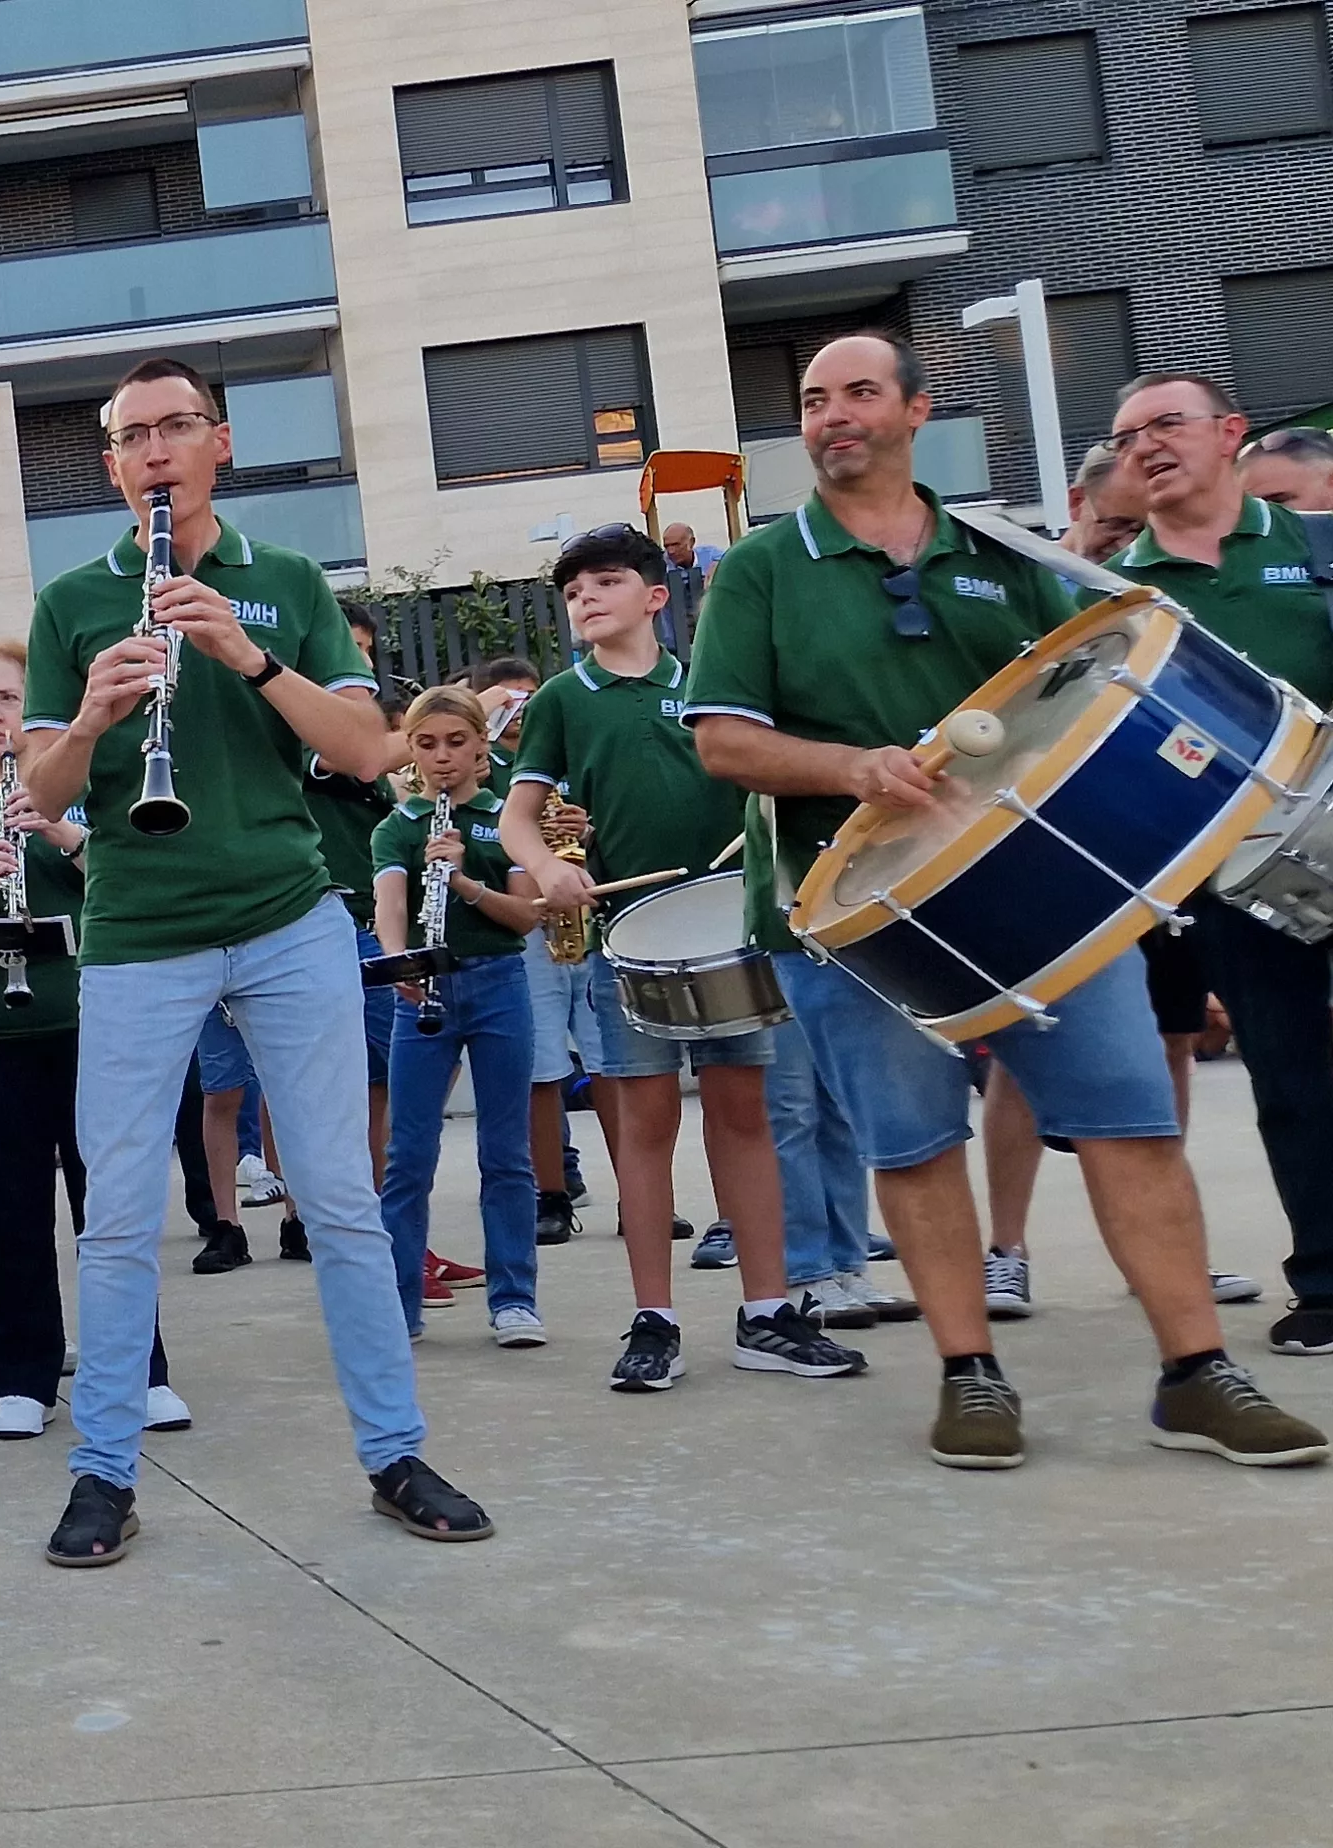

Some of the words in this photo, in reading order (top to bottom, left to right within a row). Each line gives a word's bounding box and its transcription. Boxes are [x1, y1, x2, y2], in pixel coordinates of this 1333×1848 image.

[954, 576, 1007, 602] BMH
[661, 699, 686, 713] BM
[471, 823, 501, 839] BM
